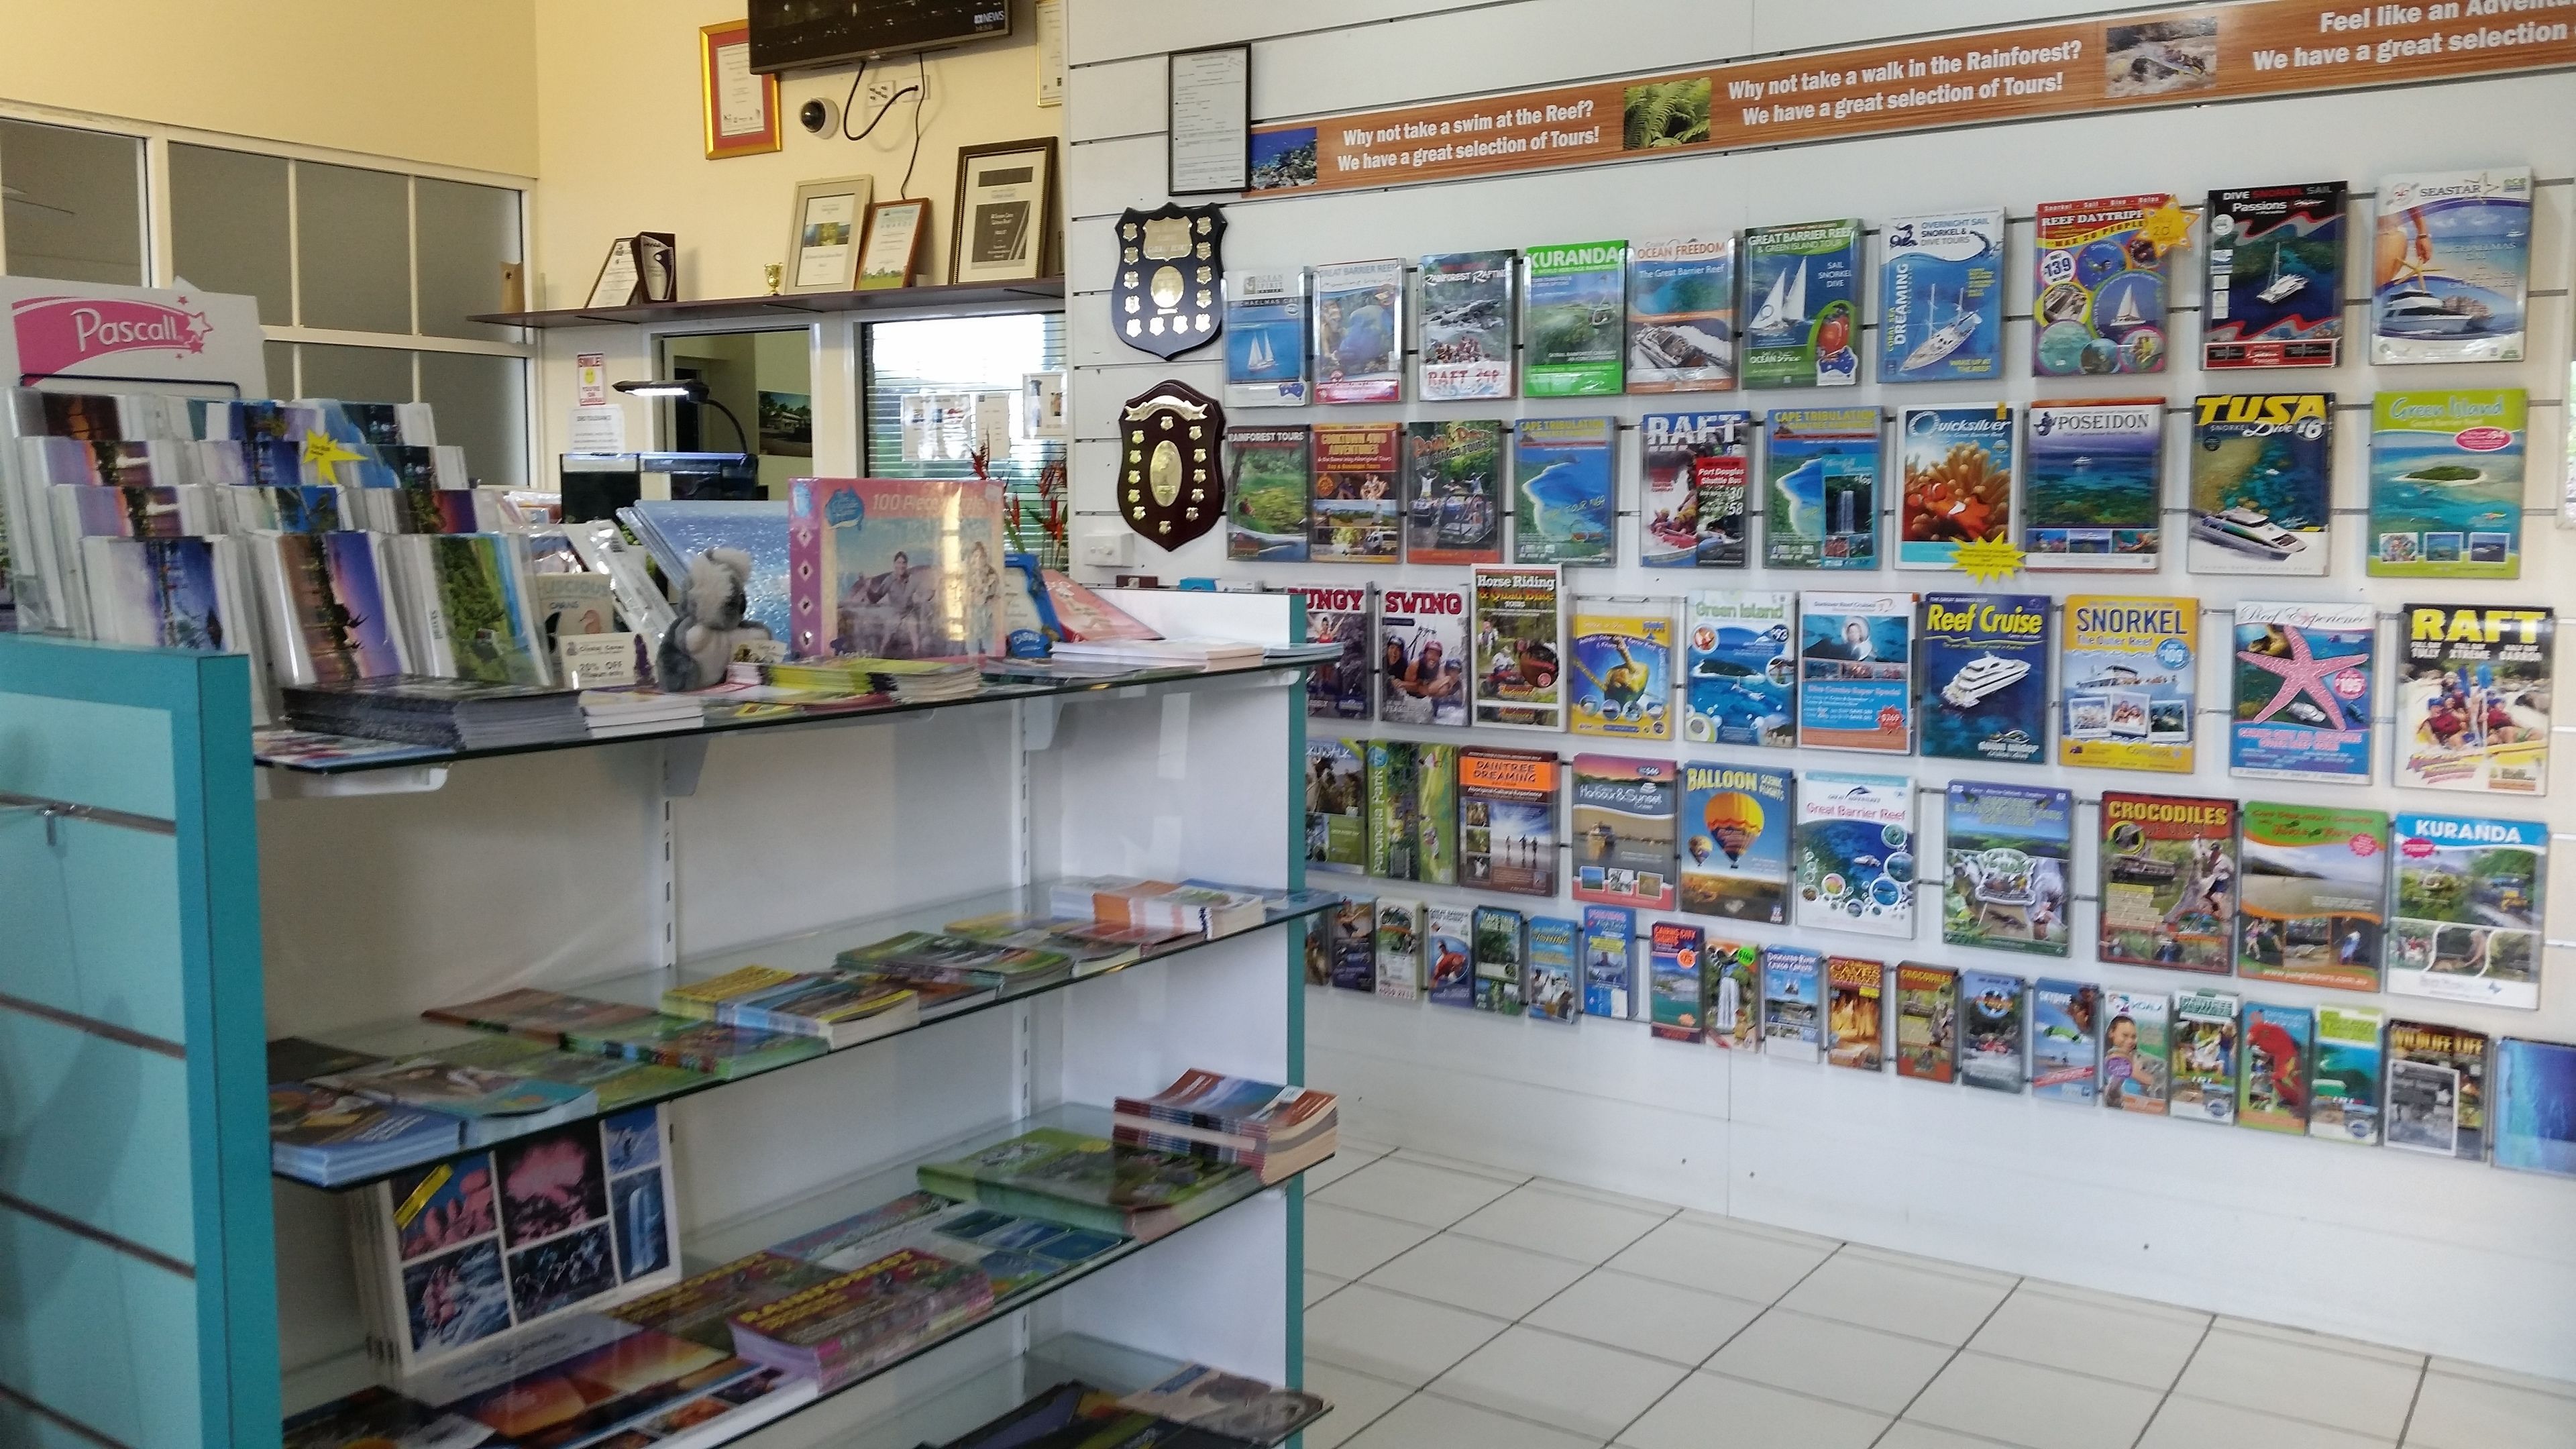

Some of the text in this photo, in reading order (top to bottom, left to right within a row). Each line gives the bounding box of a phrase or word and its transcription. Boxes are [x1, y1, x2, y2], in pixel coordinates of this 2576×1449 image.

[2319, 6, 2371, 33] Feel
[2377, 3, 2422, 27] like
[2428, 1, 2459, 21] an
[2251, 20, 2567, 72] We have a great selection
[1729, 40, 2082, 101] Why not take a walk in the Rainforest?
[1742, 72, 2064, 126] We have a great selection of Tours!
[1344, 100, 1594, 148] Why not take a swim at the Reef?
[1337, 125, 1600, 172] We have a great selection of Tours!
[2222, 191, 2250, 201] DIVE
[2306, 186, 2332, 196] SAIL
[2418, 185, 2480, 198] SEASTAR
[2232, 201, 2287, 213] Passions
[2041, 211, 2143, 227] REEF DAYTRIPP
[1748, 233, 1781, 246] GREAT
[1783, 229, 1825, 243] BARRIER
[1529, 246, 1627, 269] KURANDA
[1638, 241, 1726, 259] OCEAN FREEDOM
[1894, 262, 1910, 345] DREAMING
[70, 307, 177, 354] Pascall
[2196, 394, 2327, 426] TUSA
[2390, 397, 2445, 420] Green
[1647, 415, 1742, 445] RAFT
[2057, 413, 2149, 431] POSEIDON
[1277, 431, 1305, 442] TOURS
[1477, 574, 1556, 590] Horse Riding
[1287, 588, 1364, 611] UNGY
[1385, 592, 1462, 615] SWING
[1696, 602, 1736, 618] Green
[1927, 604, 2043, 638] Reef Cruise
[2076, 607, 2188, 635] SNORKEL
[2410, 608, 2546, 644] RAFT
[1474, 769, 1536, 784] DREAMING
[1476, 760, 1536, 772] DAINTREE
[1686, 767, 1758, 792] BALLOON
[1806, 802, 1906, 821] Great Barrier Reef
[2108, 800, 2229, 826] CROCODILES
[2415, 819, 2523, 845] KURANDA
